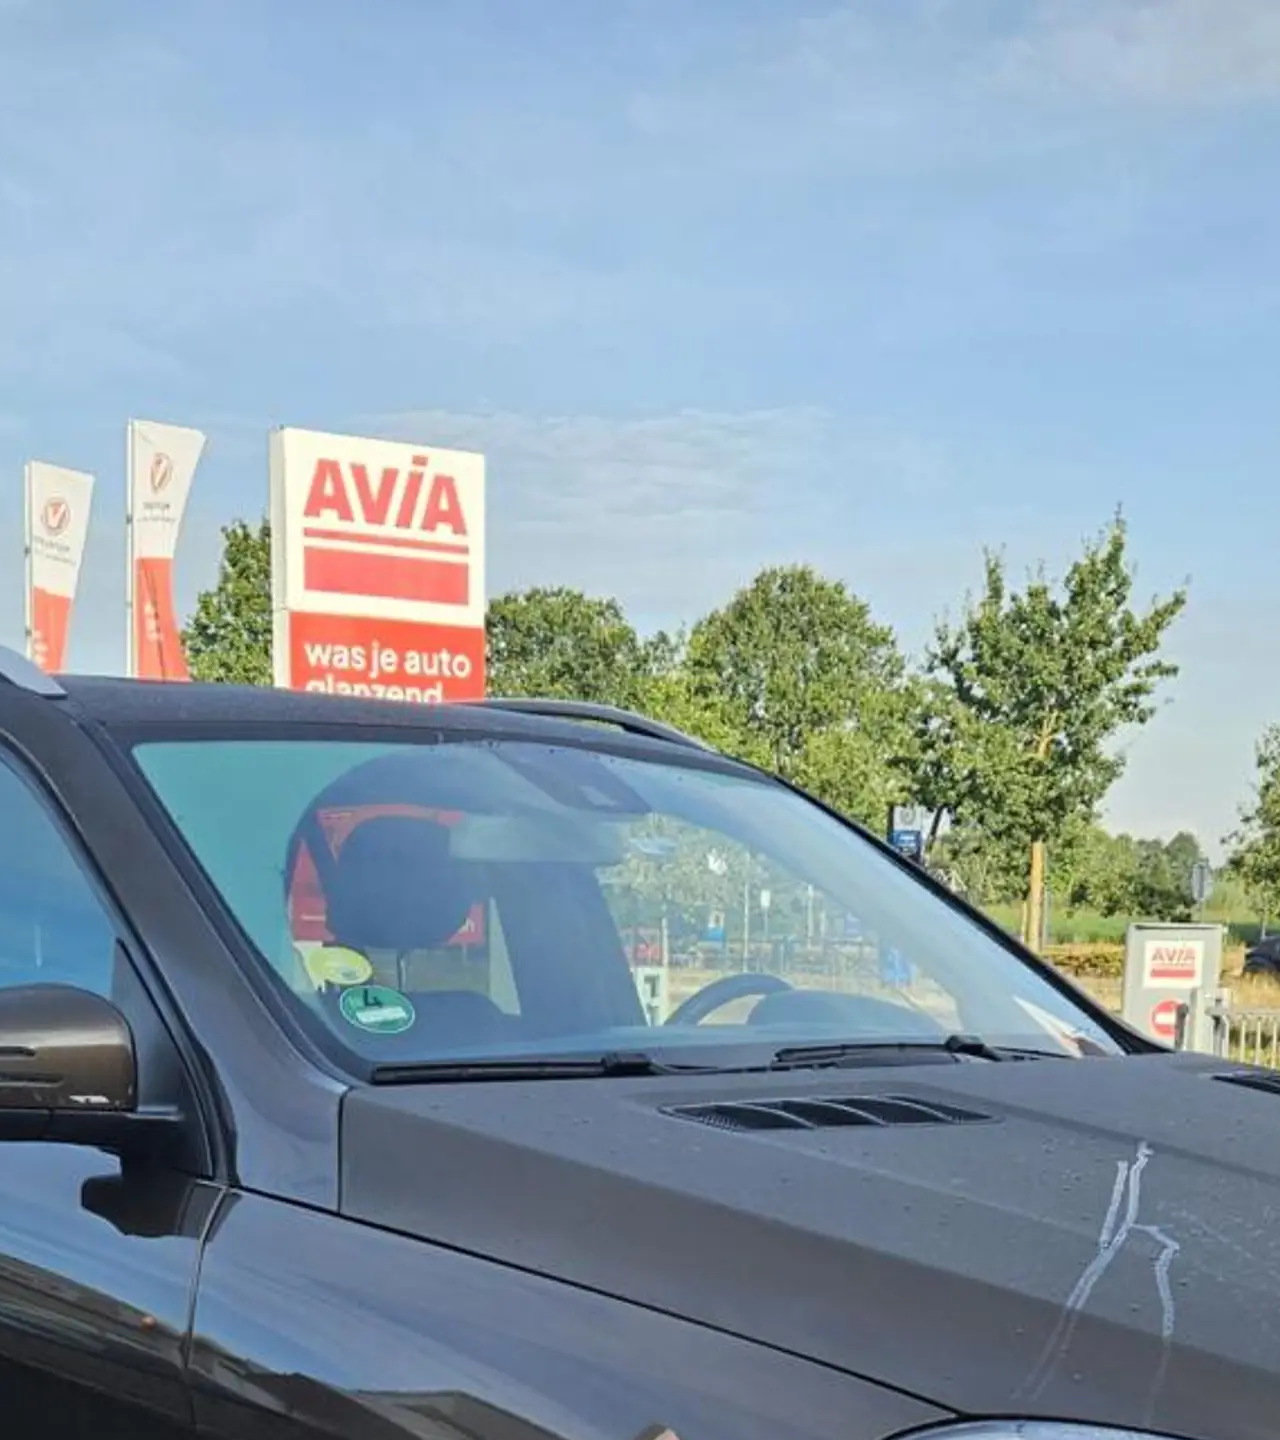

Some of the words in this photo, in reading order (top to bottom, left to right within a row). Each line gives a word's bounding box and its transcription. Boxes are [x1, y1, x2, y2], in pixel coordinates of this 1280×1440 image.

[304, 642, 366, 671] was
[369, 640, 399, 679] je
[404, 648, 472, 678] auto
